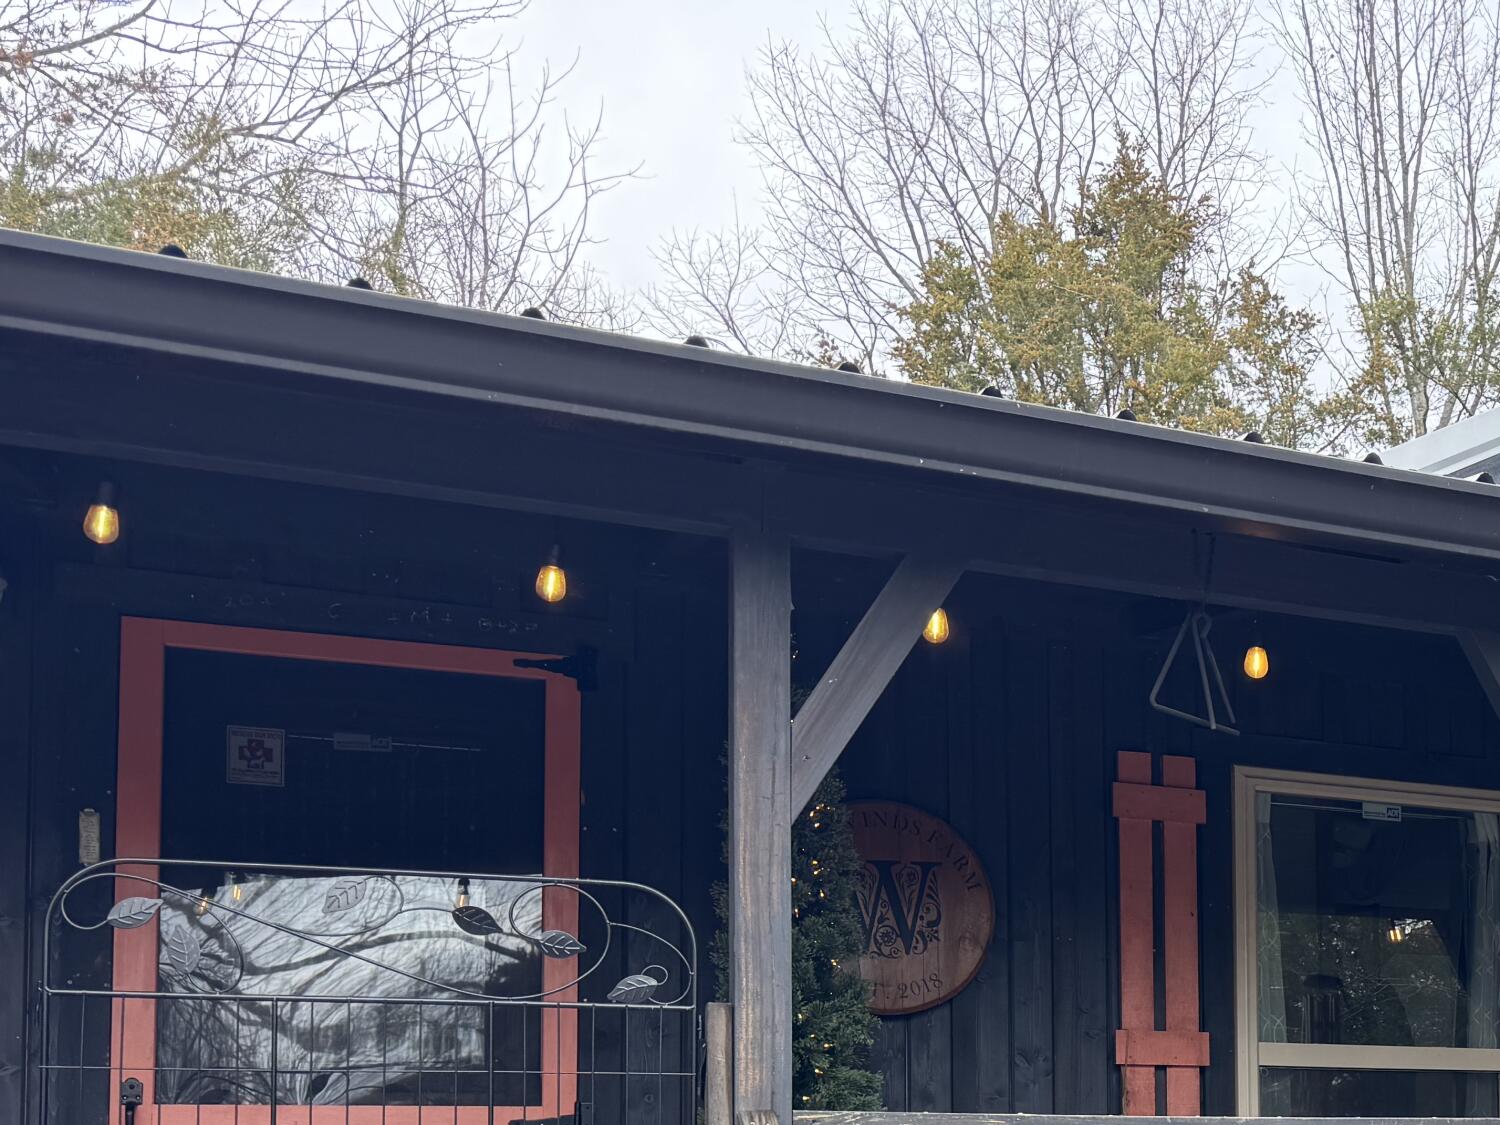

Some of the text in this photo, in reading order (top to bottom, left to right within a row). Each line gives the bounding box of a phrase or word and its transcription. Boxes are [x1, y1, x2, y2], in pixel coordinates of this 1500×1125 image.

[926, 829, 983, 891] FARM
[854, 859, 943, 955] W
[898, 972, 943, 998] 2018
